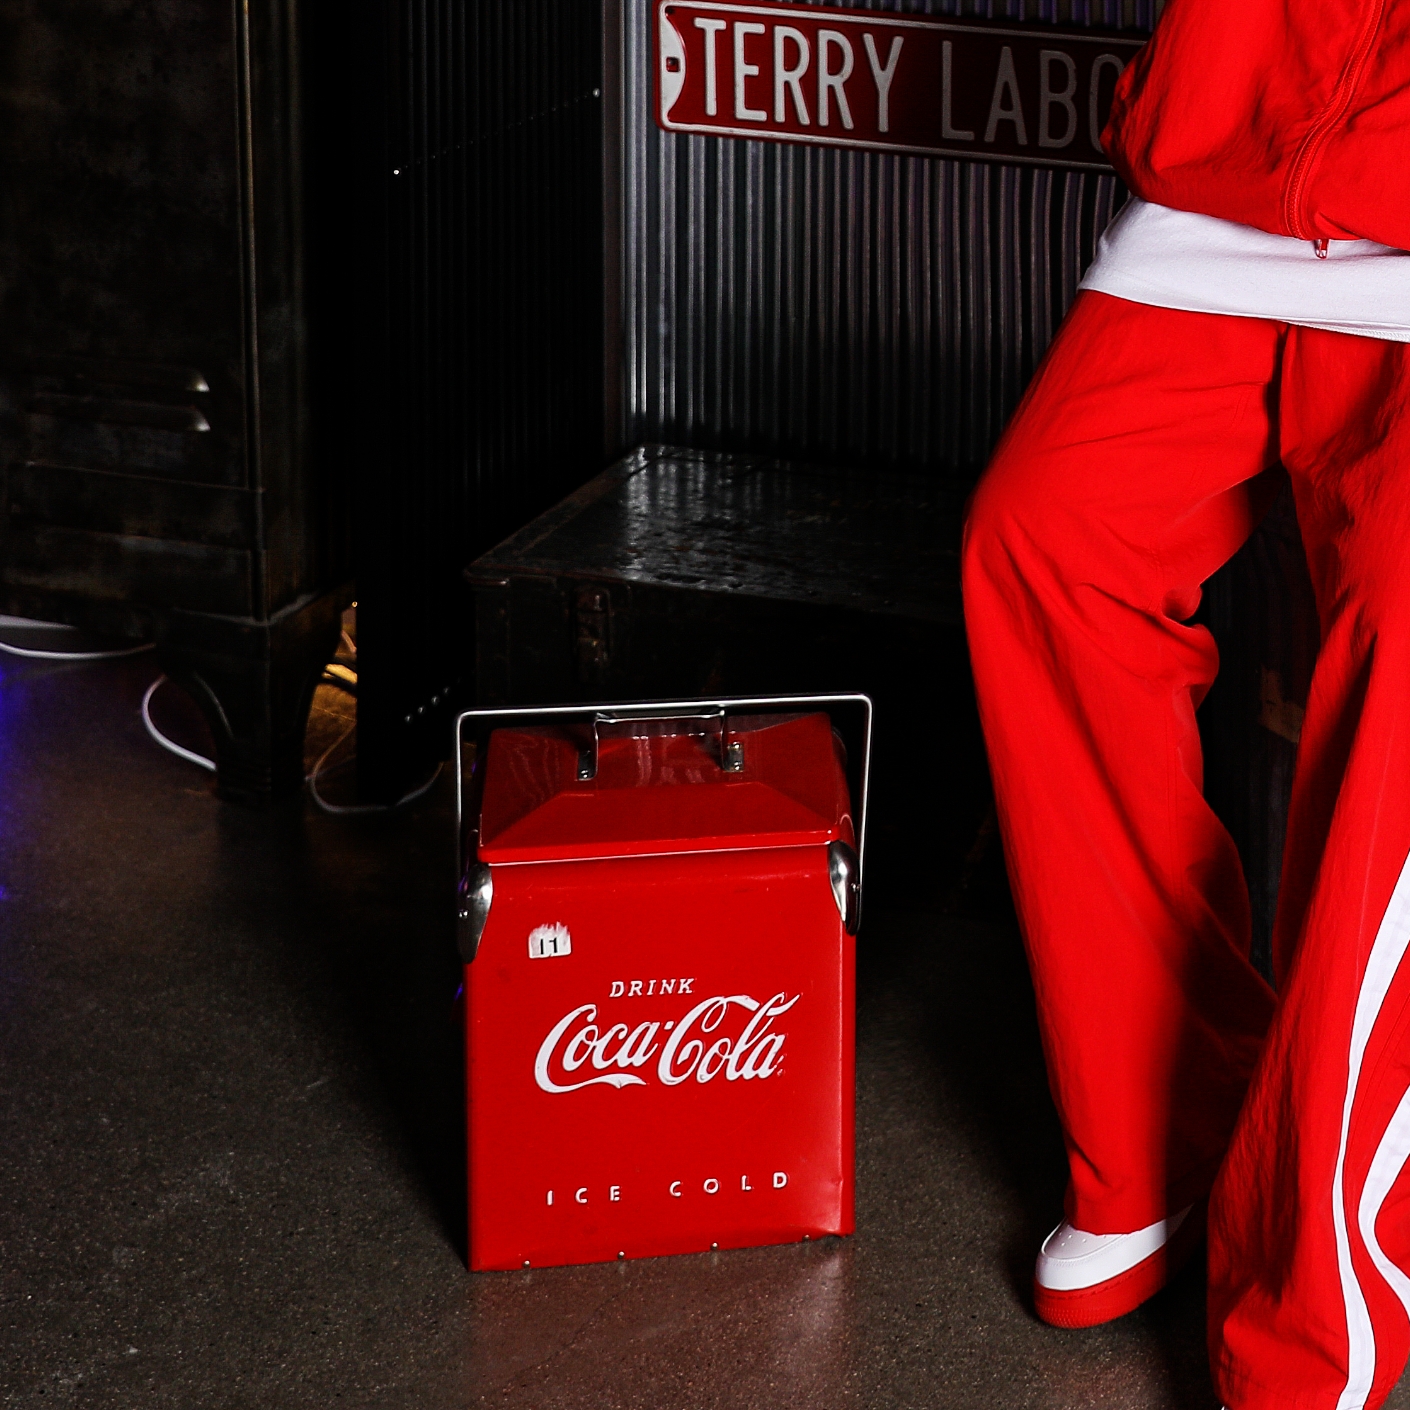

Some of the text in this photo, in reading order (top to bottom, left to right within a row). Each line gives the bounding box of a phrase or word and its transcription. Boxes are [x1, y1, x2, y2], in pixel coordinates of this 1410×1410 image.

[694, 17, 904, 133] TERRY
[609, 978, 695, 998] DRINK
[534, 991, 801, 1093] Coca-Cola
[547, 1172, 788, 1206] ICE COLD
